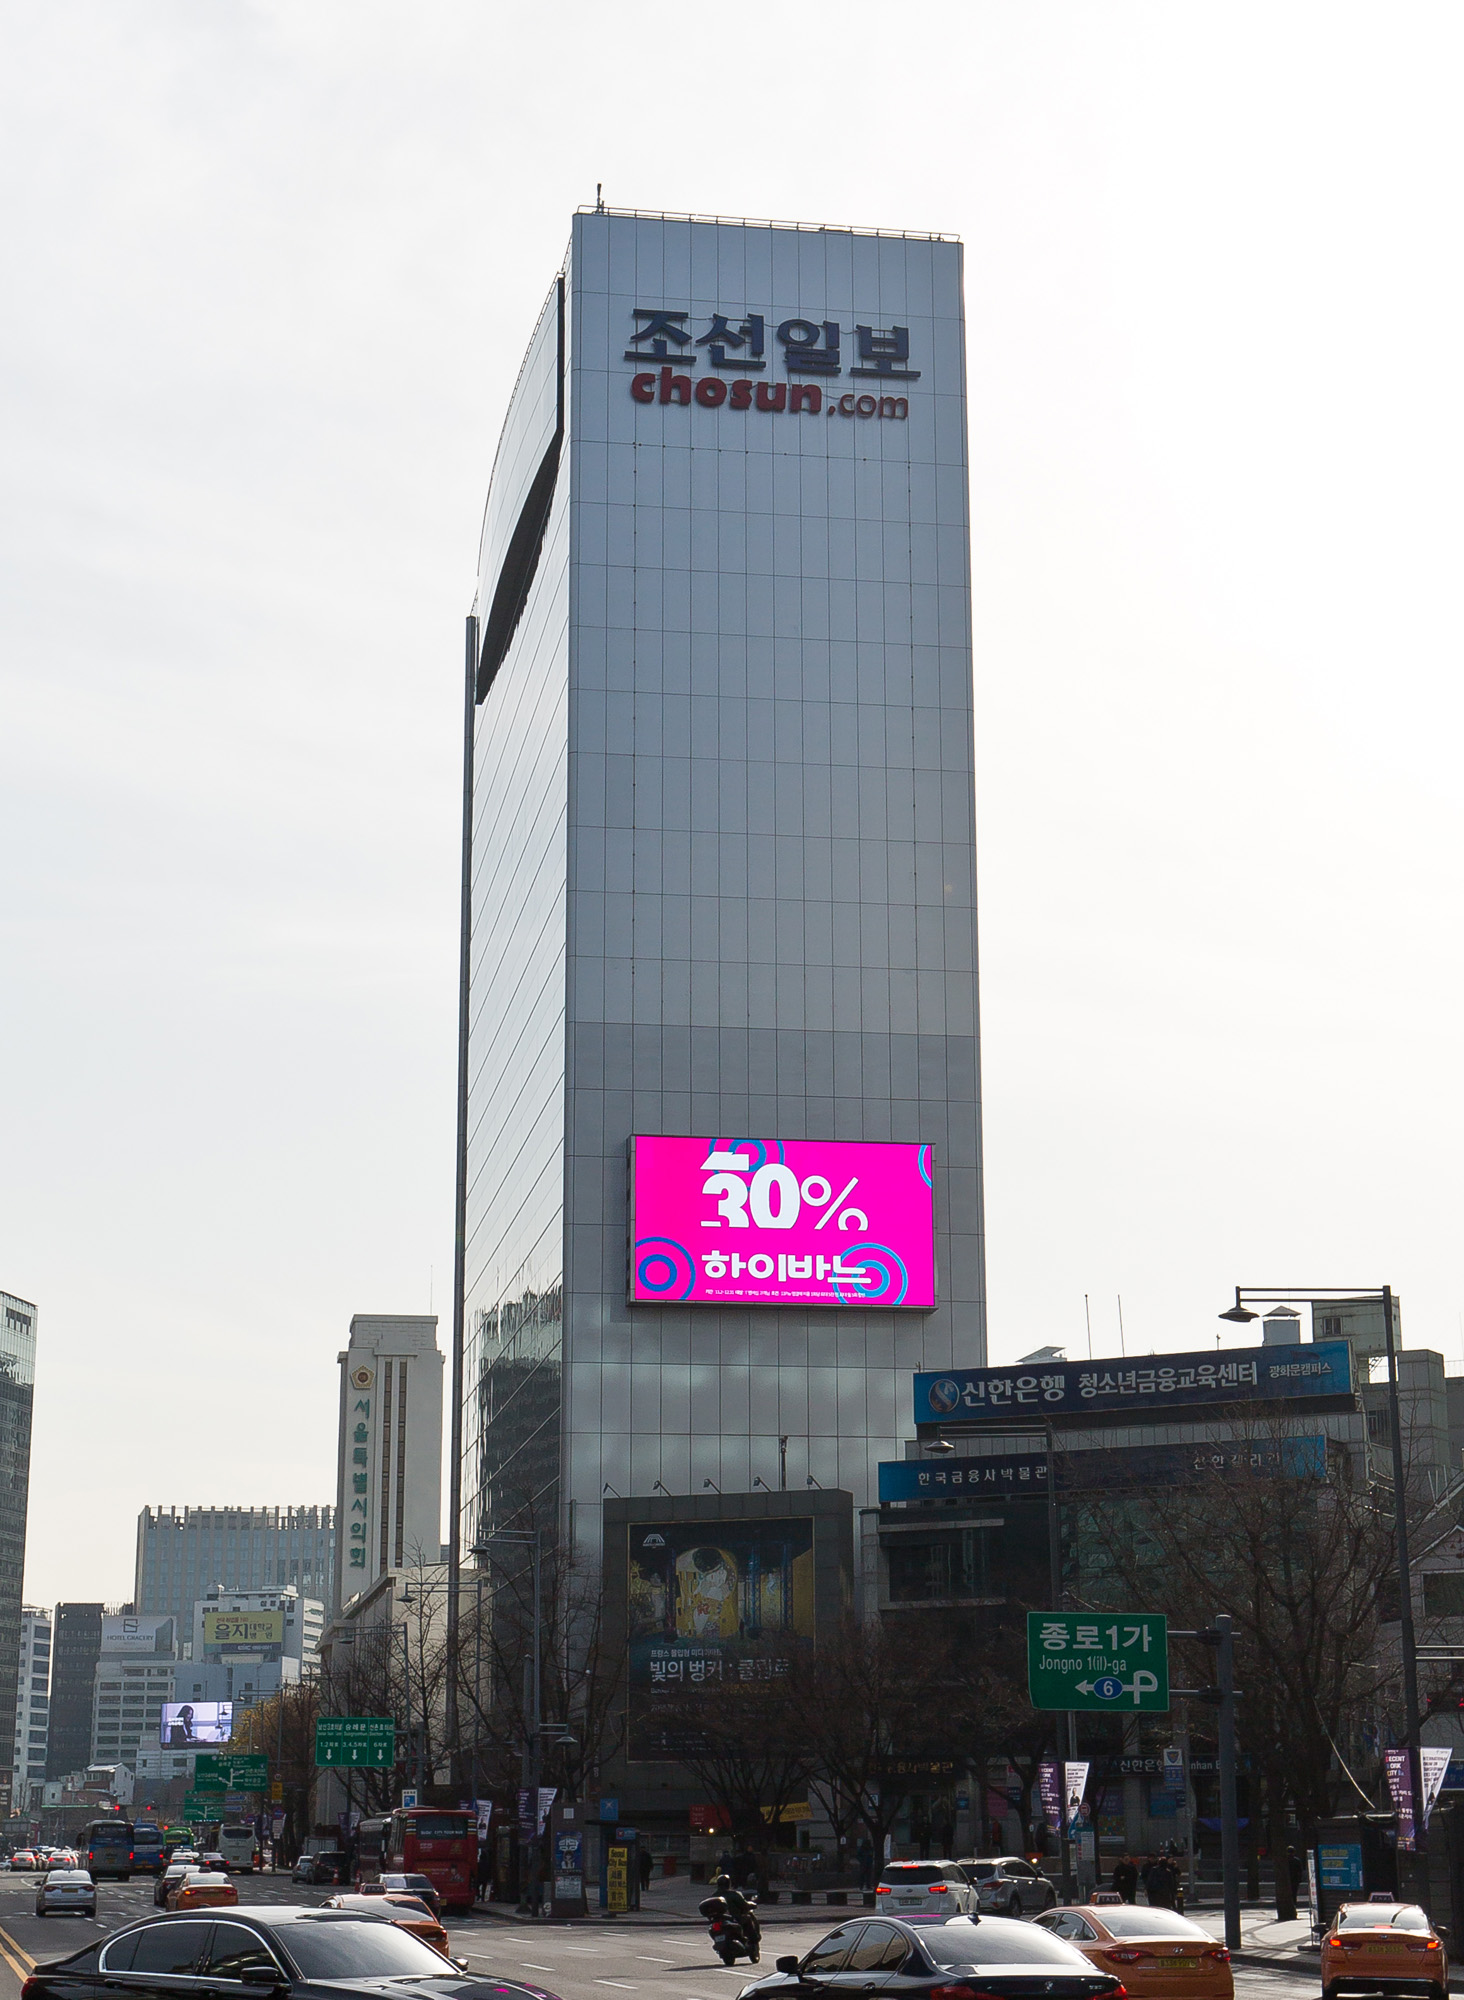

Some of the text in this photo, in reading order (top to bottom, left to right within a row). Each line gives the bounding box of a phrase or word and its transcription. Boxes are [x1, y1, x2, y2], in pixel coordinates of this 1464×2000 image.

[624, 308, 921, 377] 조선일보
[631, 366, 909, 419] chosun.com
[961, 1360, 1333, 1408] 신한은행 청소년금융교육센터 광화문캠퍼스
[349, 1398, 370, 1570] 서울특별시의회
[917, 1465, 1048, 1485] 한국금융사박물관
[214, 1623, 249, 1640] 을지
[1039, 1622, 1153, 1653] 종로1가
[649, 1660, 684, 1682] 빛의
[688, 1660, 723, 1682] 벙커
[1039, 1655, 1127, 1675] Jongno 1(il)-ga
[1103, 1681, 1113, 1696] 6
